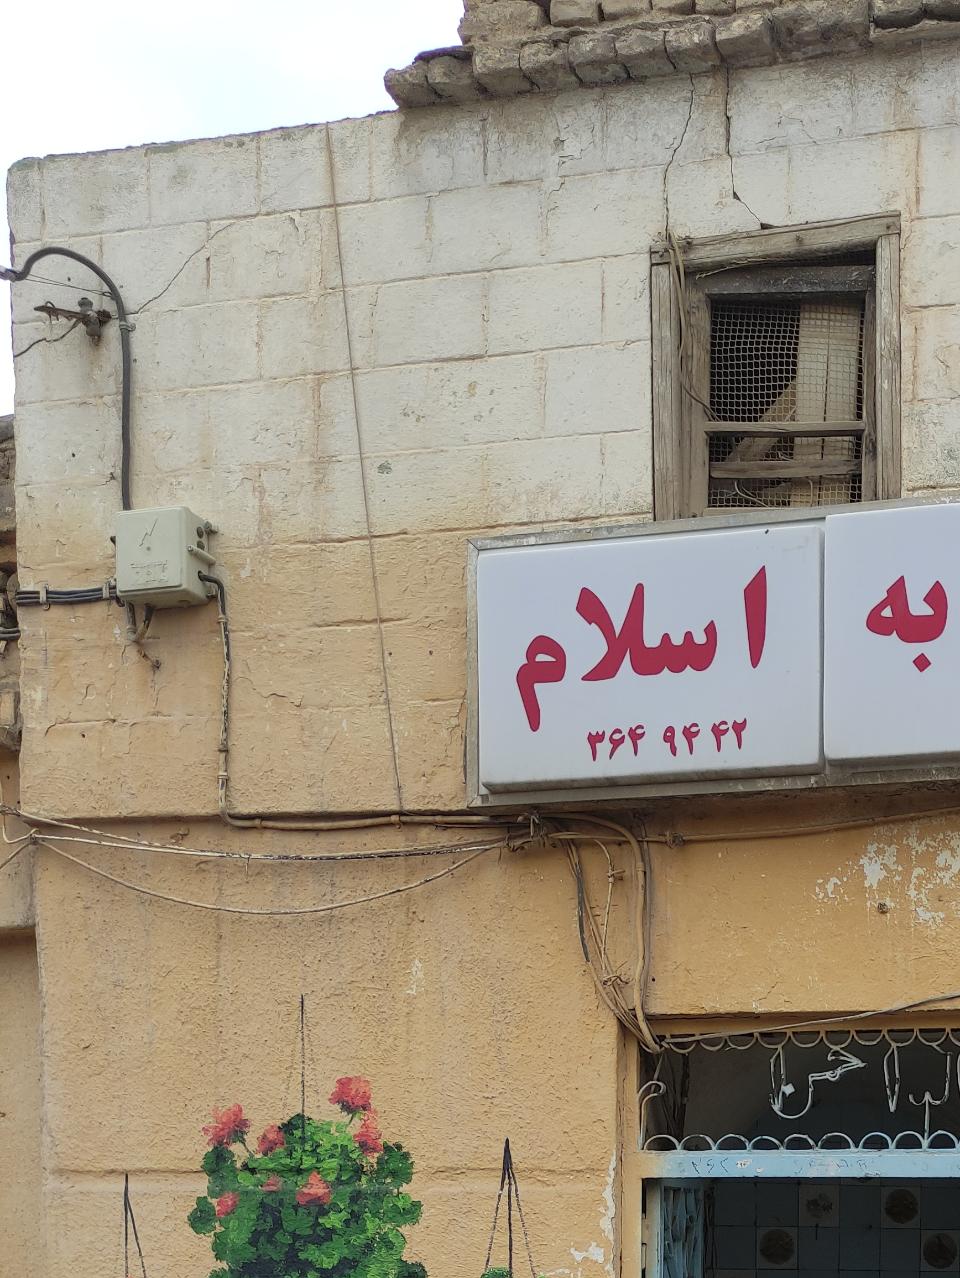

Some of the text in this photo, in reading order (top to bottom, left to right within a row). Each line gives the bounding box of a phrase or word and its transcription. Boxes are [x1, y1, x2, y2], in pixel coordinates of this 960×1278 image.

[516, 566, 768, 732] اسلام
[587, 717, 747, 761] ۳۶۴ ۹۴ ۴۲
